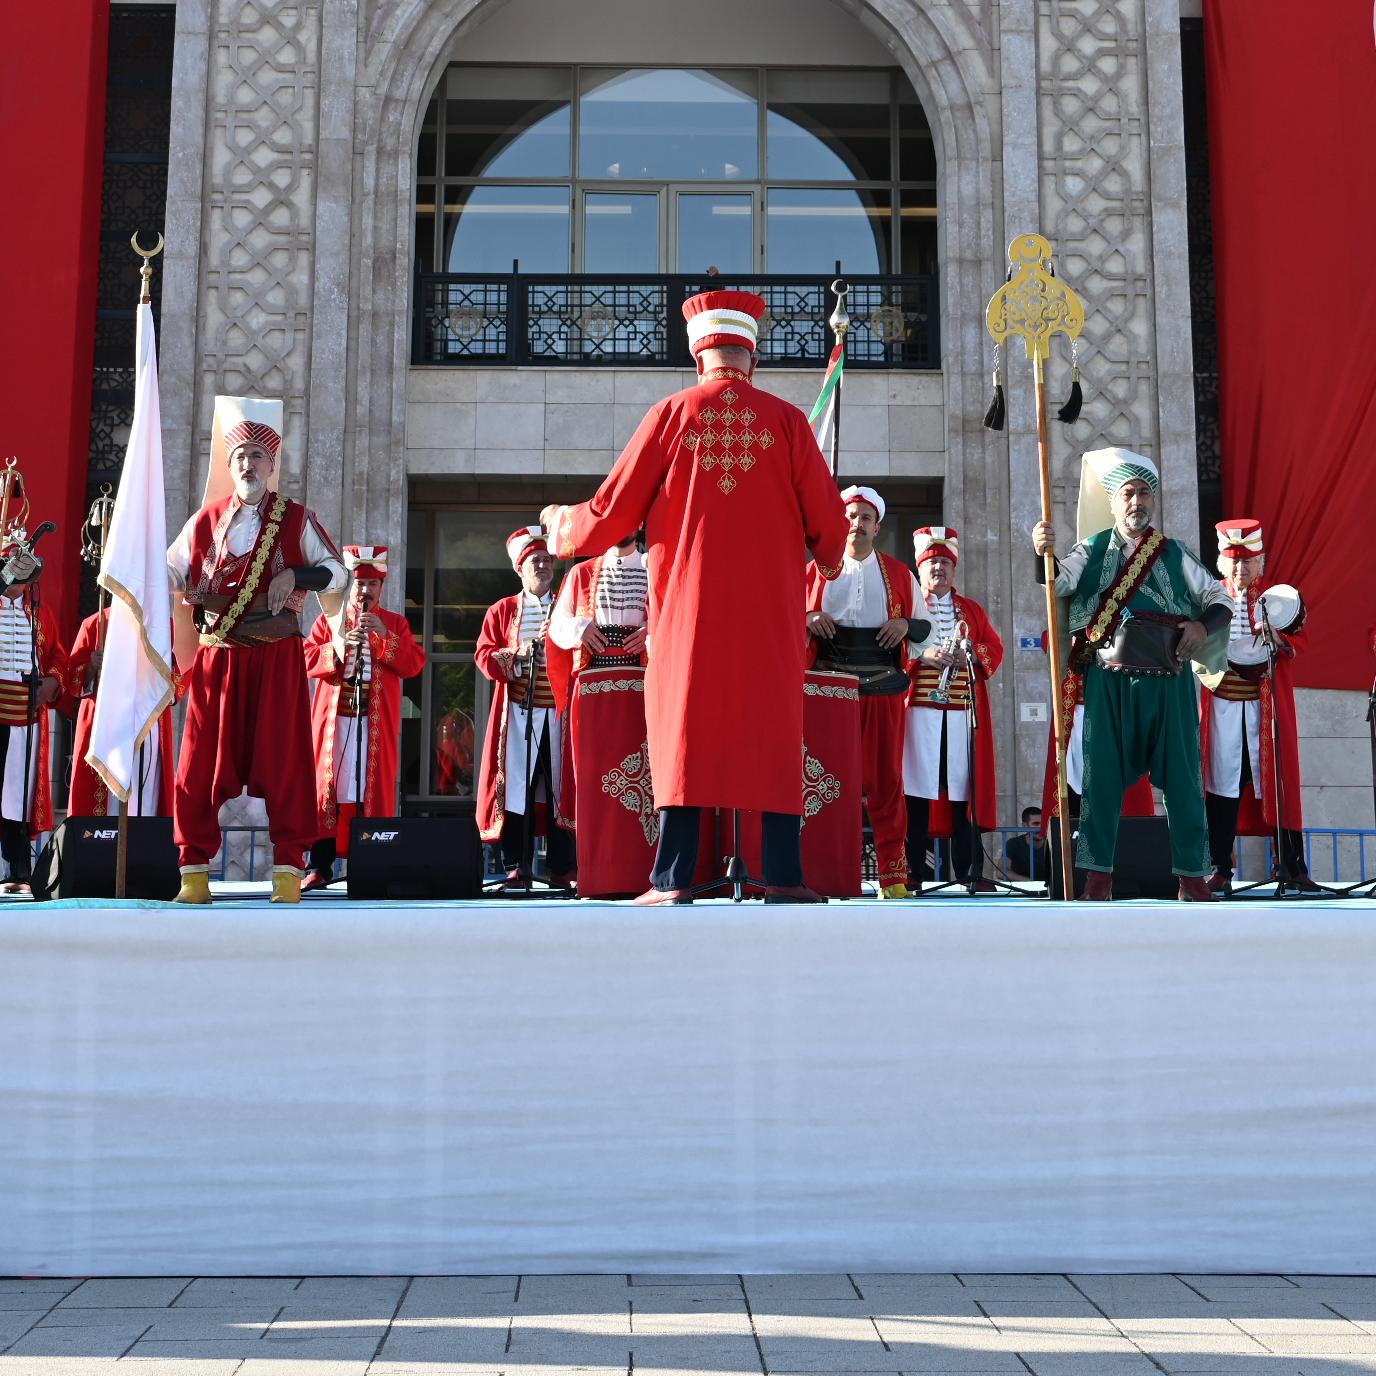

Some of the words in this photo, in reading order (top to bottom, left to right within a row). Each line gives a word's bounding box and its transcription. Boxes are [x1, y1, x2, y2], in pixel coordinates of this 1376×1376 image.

[1026, 638, 1035, 648] 3
[94, 829, 119, 839] NET
[371, 831, 399, 841] NET
